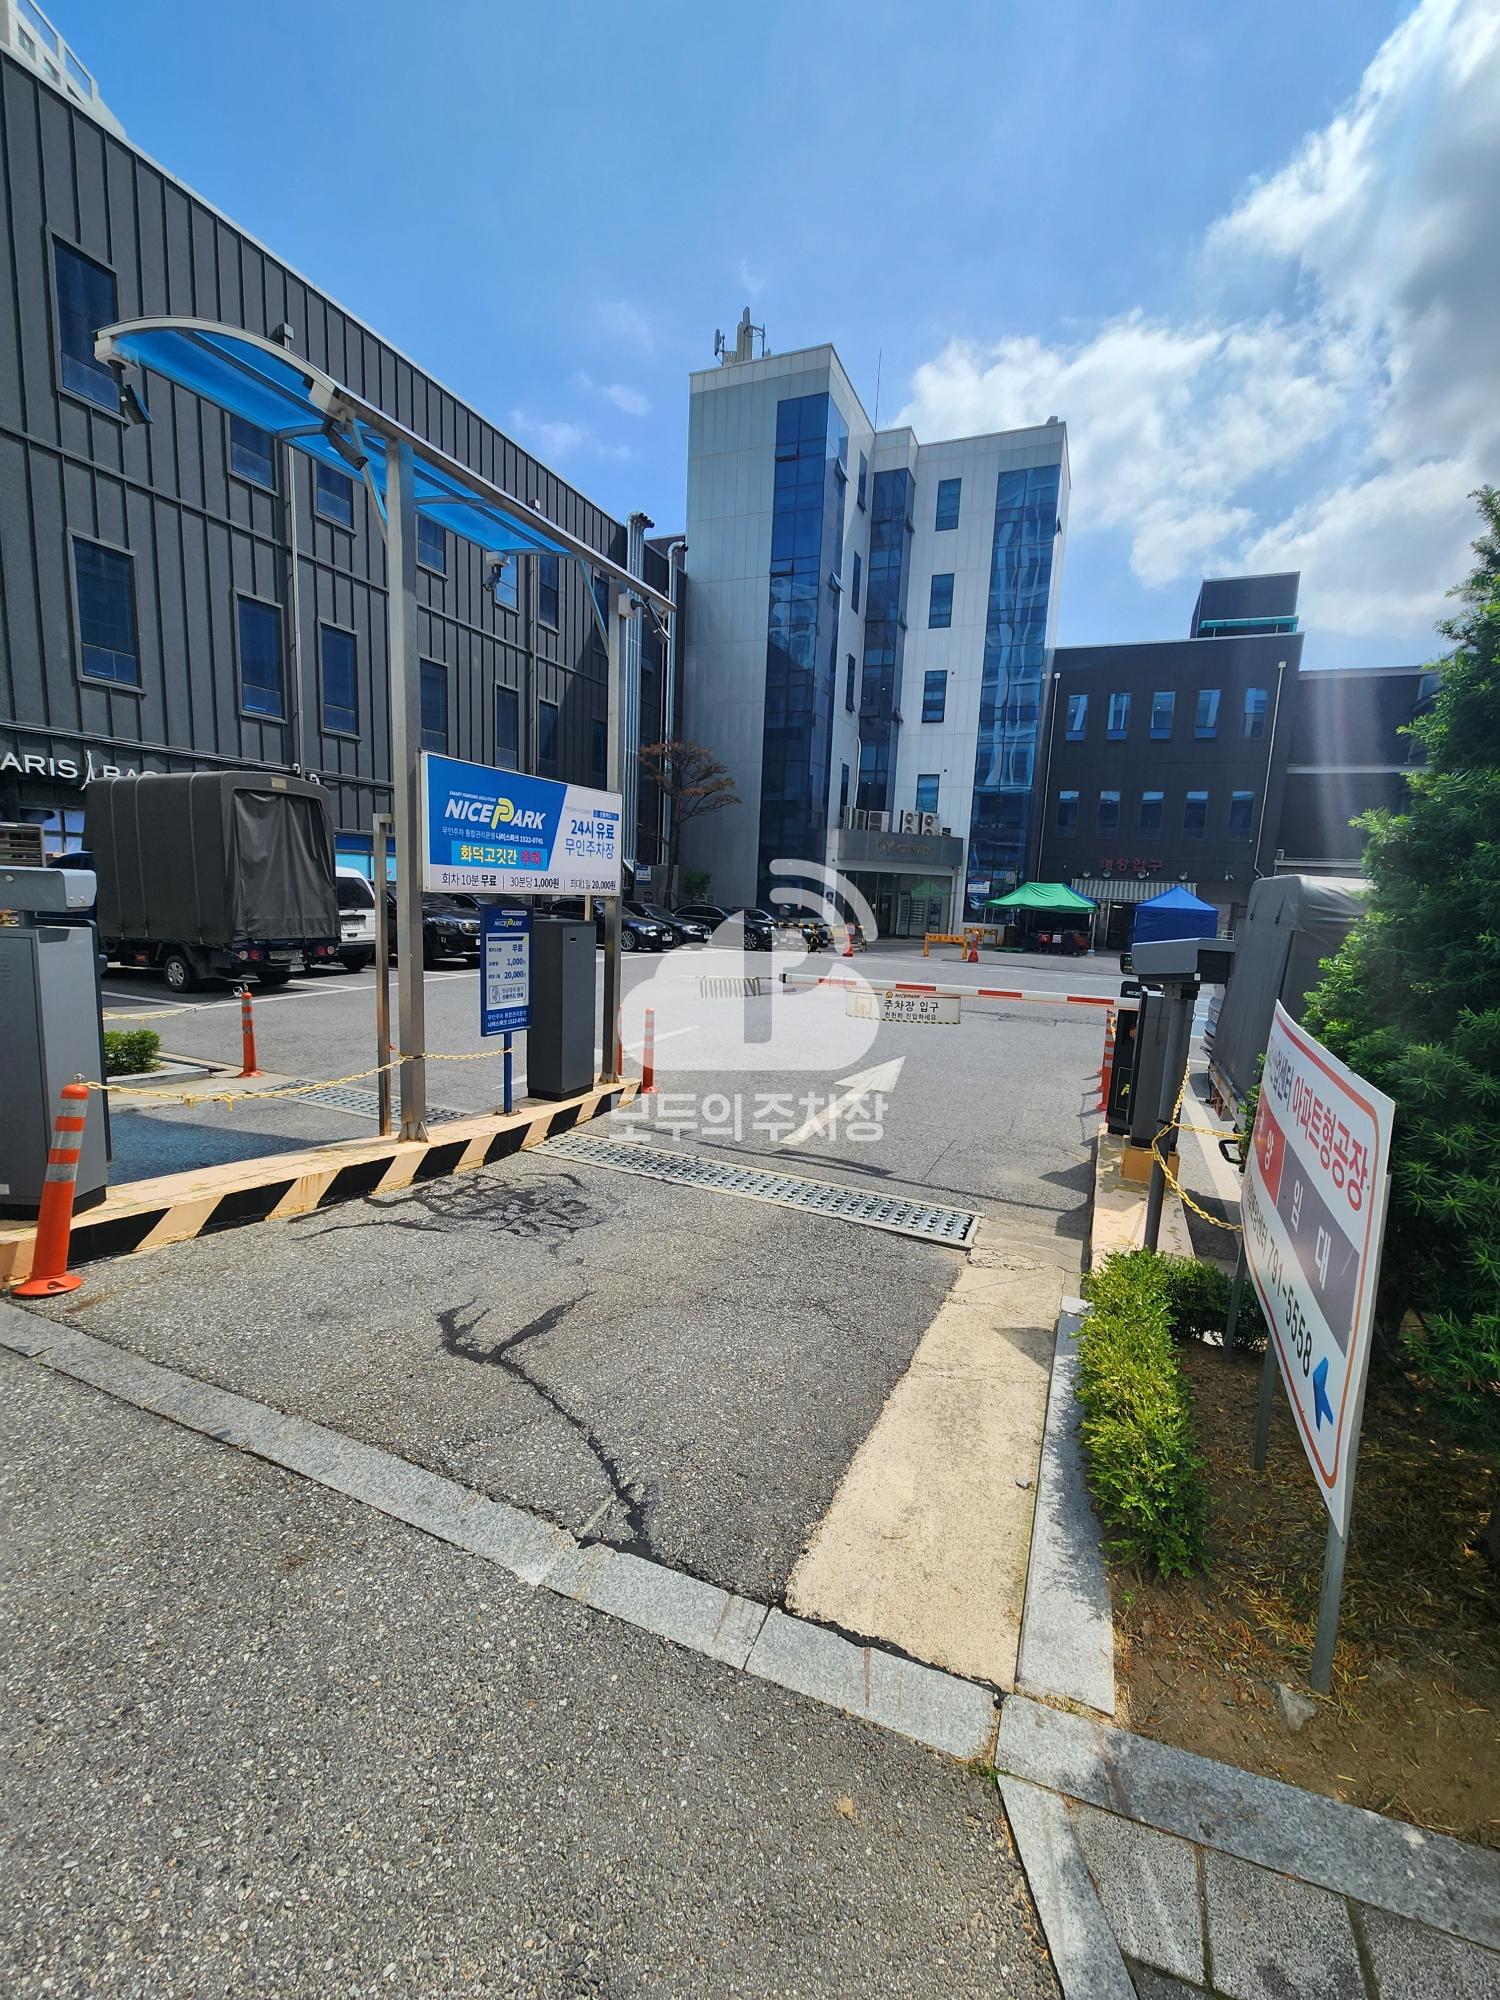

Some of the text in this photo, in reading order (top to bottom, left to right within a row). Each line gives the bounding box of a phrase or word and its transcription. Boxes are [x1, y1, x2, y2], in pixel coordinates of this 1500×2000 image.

[444, 797, 546, 830] NICEPARK
[442, 826, 464, 837] 무인주차
[465, 829, 495, 841] 통합관리운영
[496, 832, 519, 843] 나이스파크
[571, 819, 615, 840] 24시 유료
[460, 844, 518, 865] 화덕고깃간
[564, 838, 614, 860] 무인주차장
[442, 872, 497, 888] 회차 10분 무료
[510, 876, 560, 890] 30분당 1,000원
[591, 880, 617, 892] 20,000원
[512, 943, 523, 953] 무료
[883, 999, 940, 1013] 주차장 입구
[884, 1011, 937, 1021] 천천히 진입하세요
[1292, 1075, 1368, 1212] 아파트형공장
[1267, 1234, 1313, 1379] 791-5558
